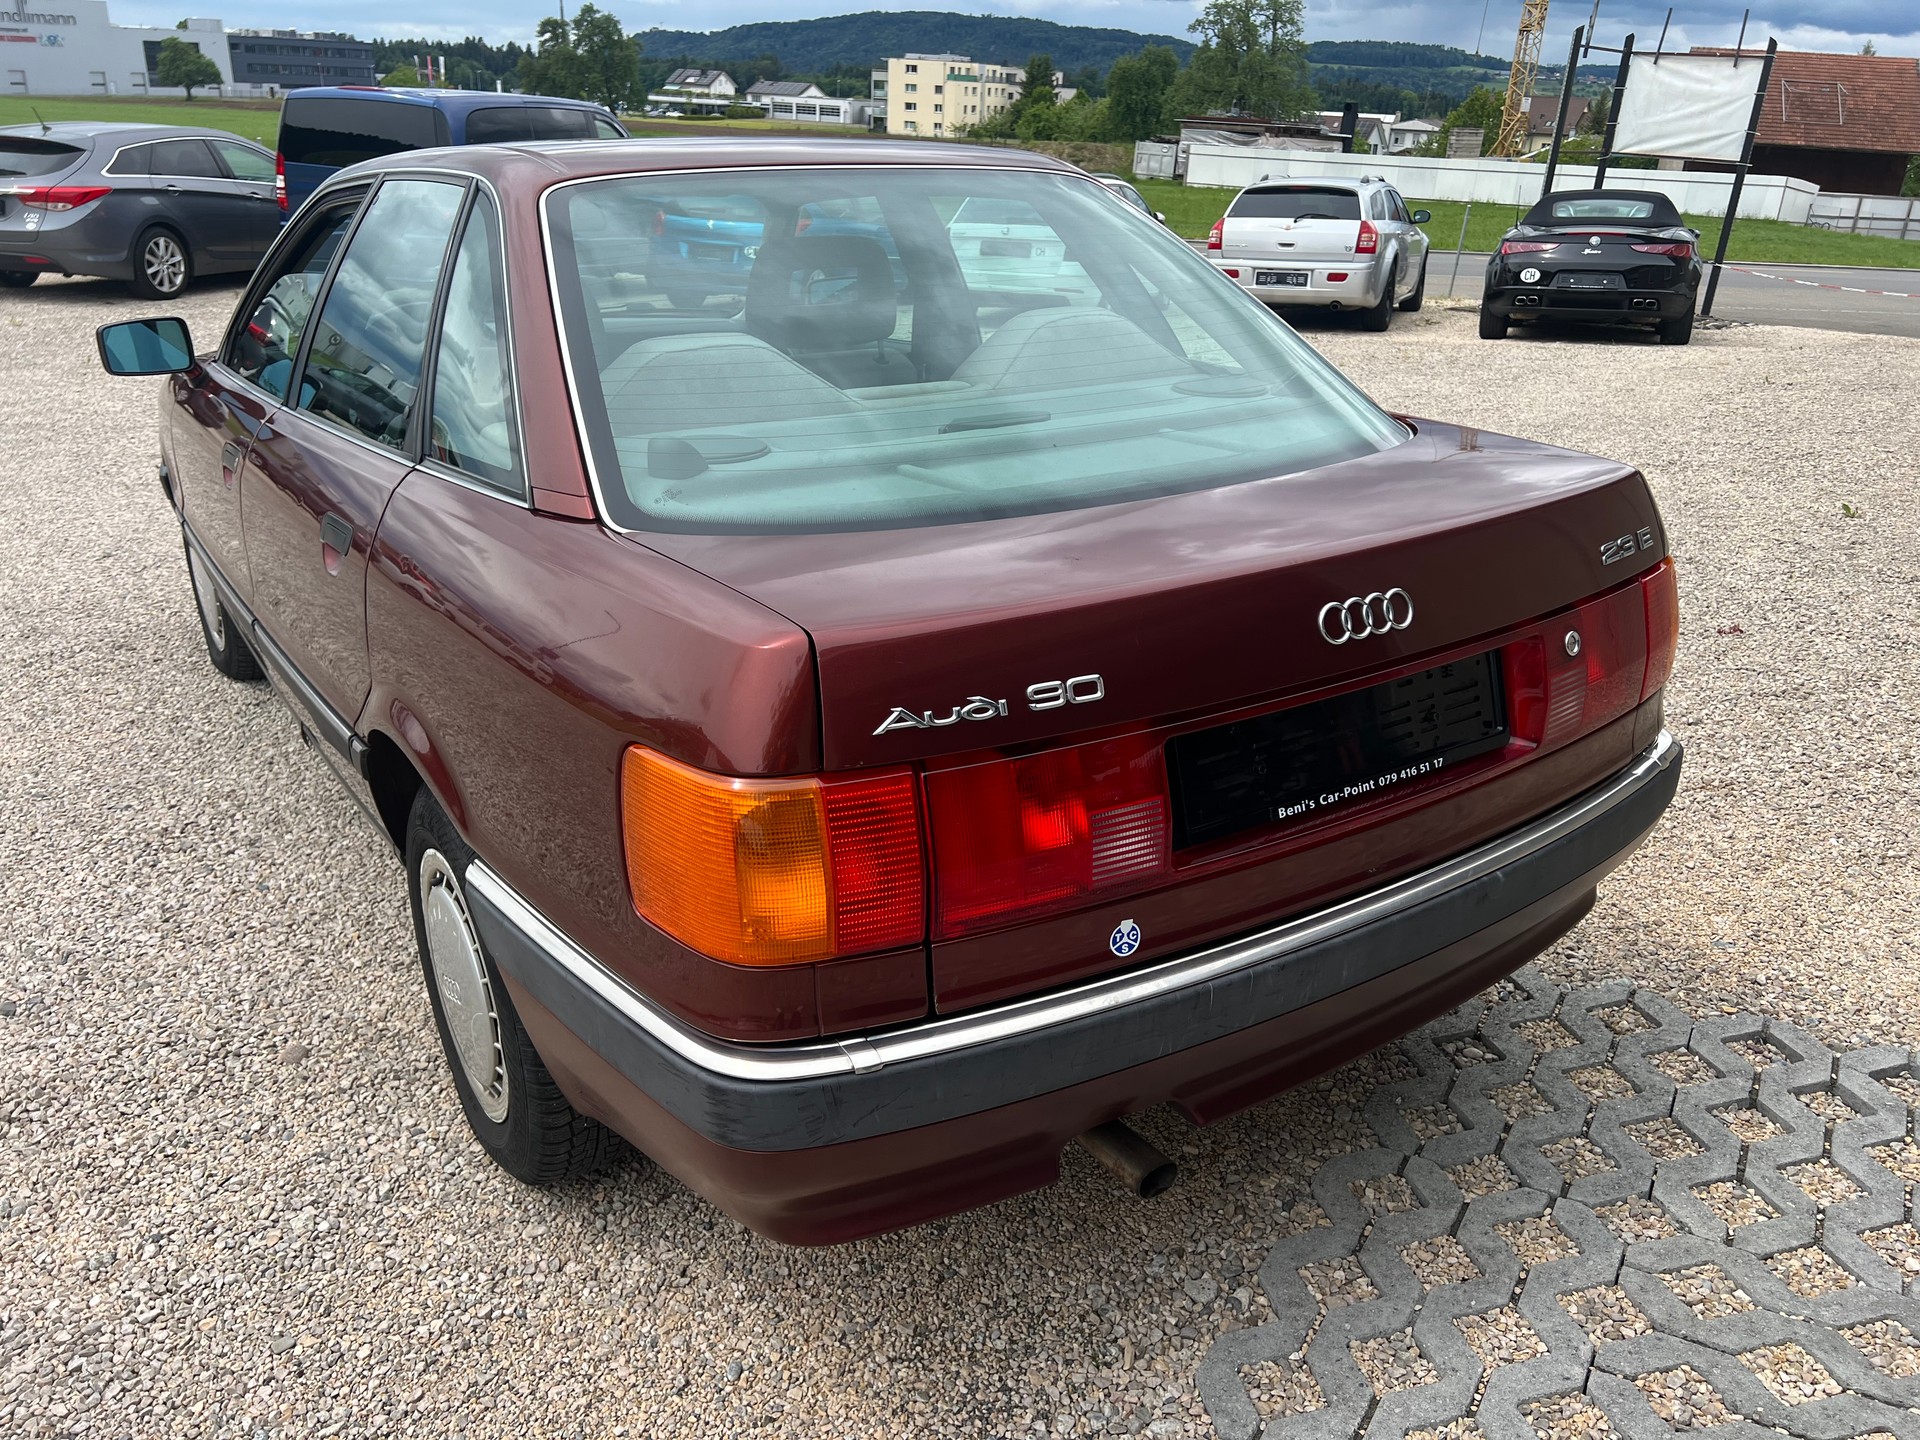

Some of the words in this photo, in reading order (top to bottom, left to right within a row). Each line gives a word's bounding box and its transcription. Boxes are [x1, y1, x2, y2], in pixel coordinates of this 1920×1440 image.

[1524, 270, 1536, 281] CH
[1637, 525, 1654, 551] E
[872, 695, 1009, 736] Audi
[1027, 673, 1105, 711] 90
[1278, 799, 1316, 819] Beni's
[1319, 780, 1375, 806] Car-Point
[1379, 773, 1398, 787] 079
[1400, 766, 1417, 780] 416
[1420, 762, 1431, 773] 51
[1433, 757, 1444, 768] 17
